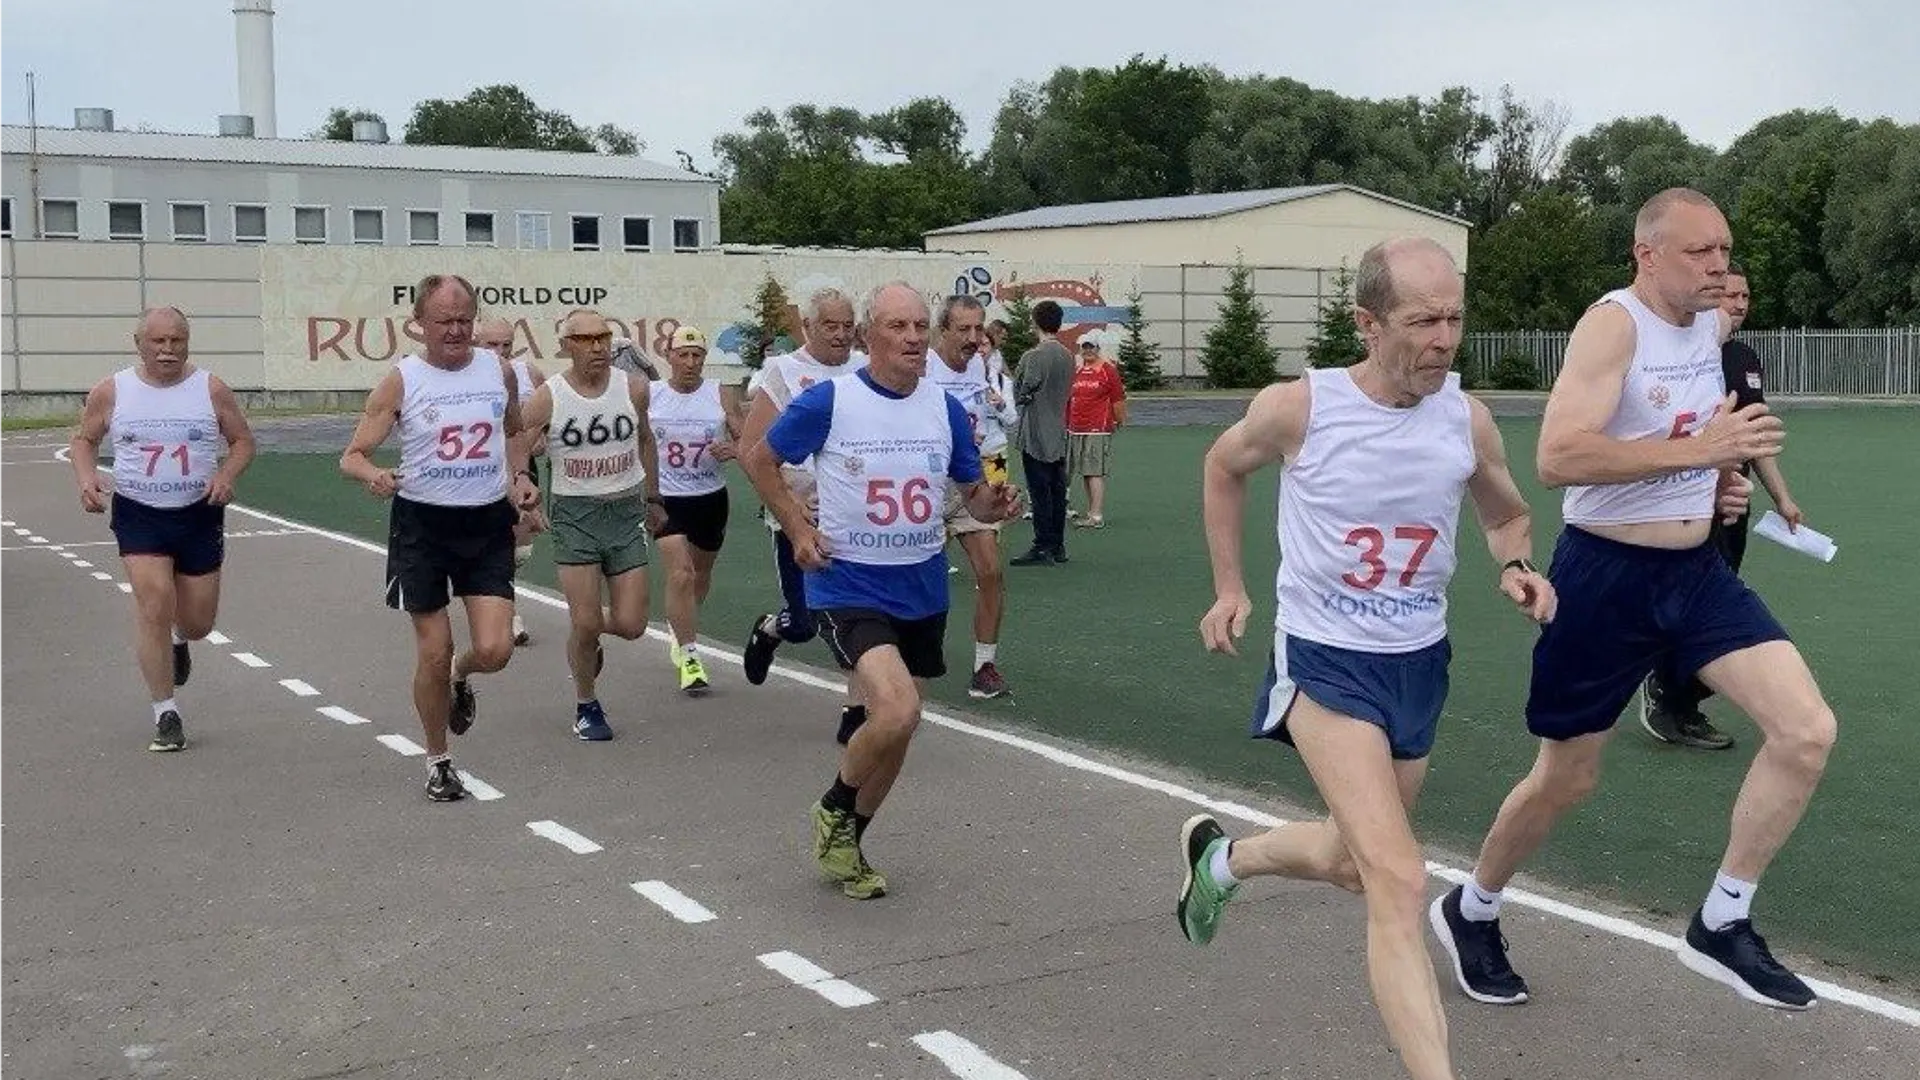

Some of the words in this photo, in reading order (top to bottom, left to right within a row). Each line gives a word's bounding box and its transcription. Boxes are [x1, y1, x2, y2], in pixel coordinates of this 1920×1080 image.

[475, 286, 552, 306] ORLD
[558, 287, 608, 306] CUP
[561, 413, 635, 448] 660
[1667, 403, 1721, 441] 5
[436, 421, 493, 461] 52
[667, 437, 713, 469] 87
[139, 445, 190, 477] 71
[866, 478, 933, 526] 56
[1341, 527, 1439, 590] 37
